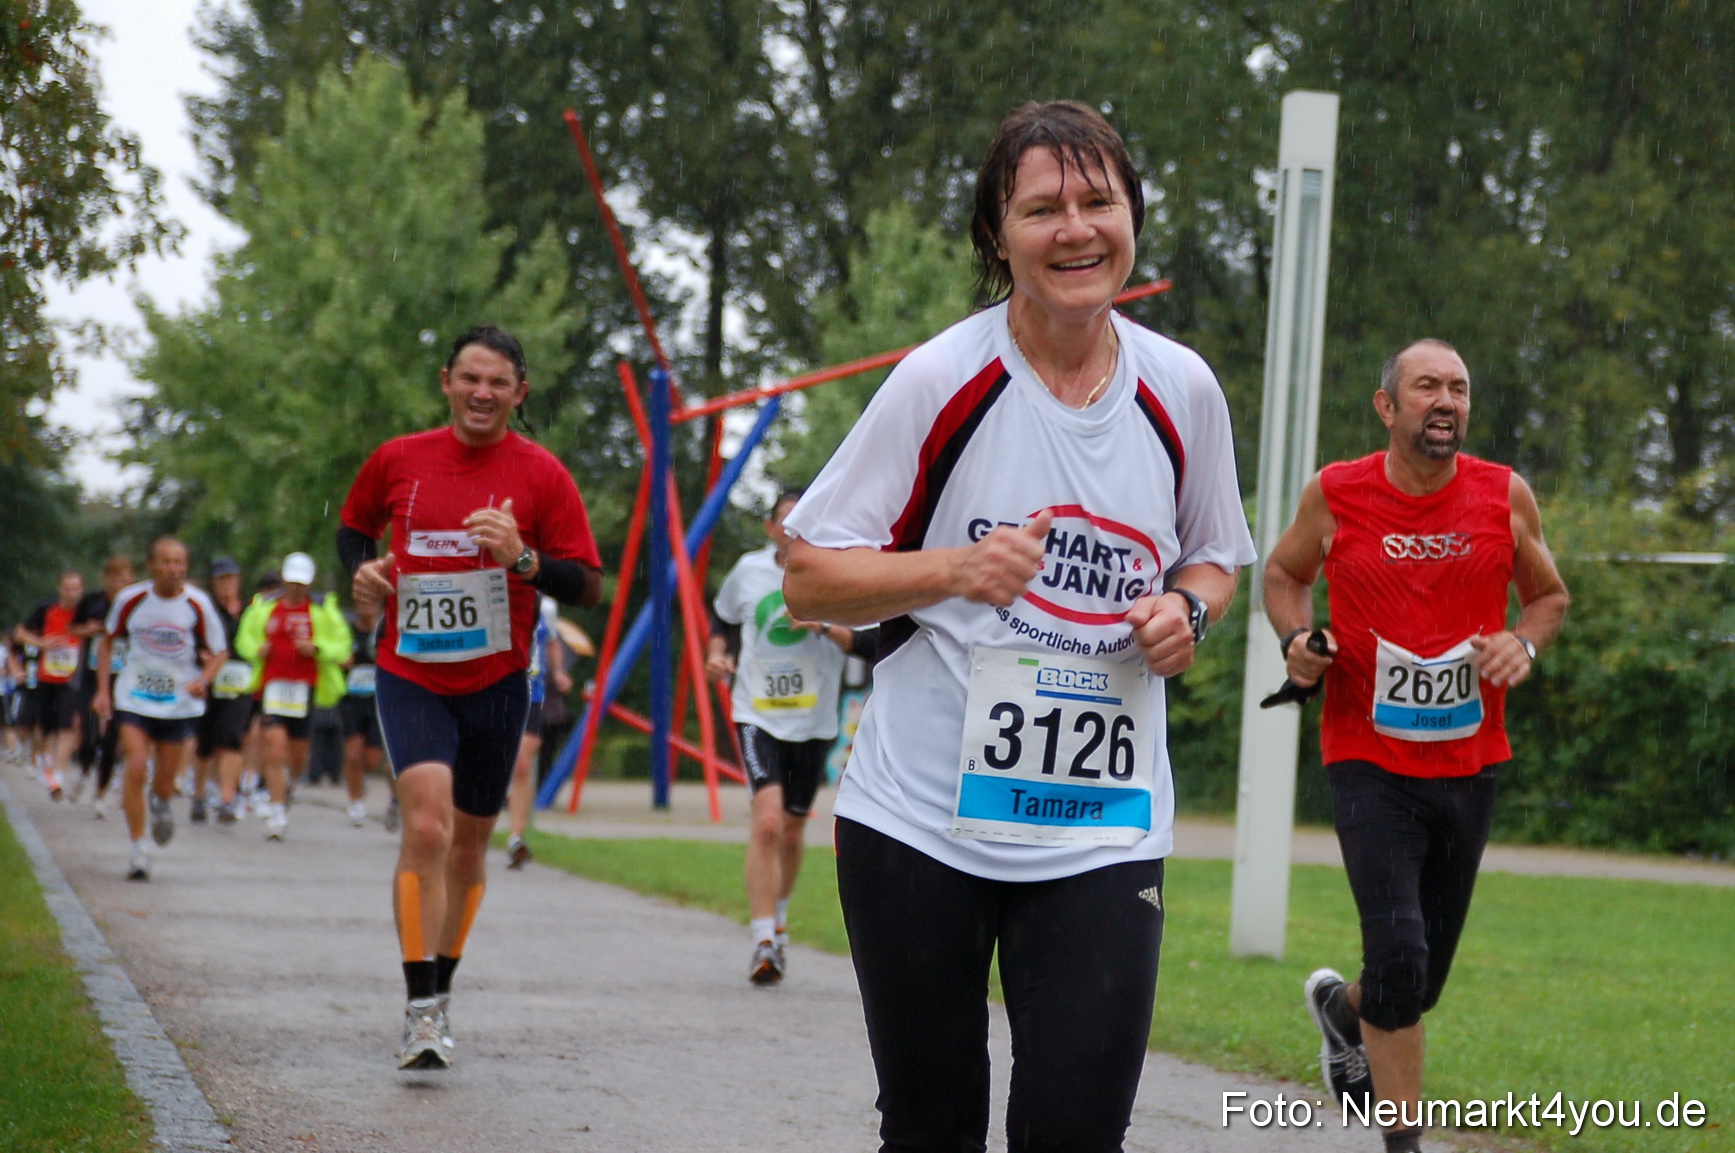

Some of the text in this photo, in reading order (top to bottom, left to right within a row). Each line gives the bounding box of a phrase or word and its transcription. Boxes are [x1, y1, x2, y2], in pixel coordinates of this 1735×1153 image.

[967, 518, 1143, 573] GHART &
[406, 596, 478, 630] 2136
[1009, 616, 1091, 656] sportliche
[765, 674, 803, 697] 309
[1037, 668, 1109, 692] BOCK
[1387, 662, 1472, 706] 2620
[1411, 713, 1453, 728] Josef
[983, 701, 1136, 782] 3126
[968, 759, 976, 771] B
[1011, 788, 1104, 820] Tamara
